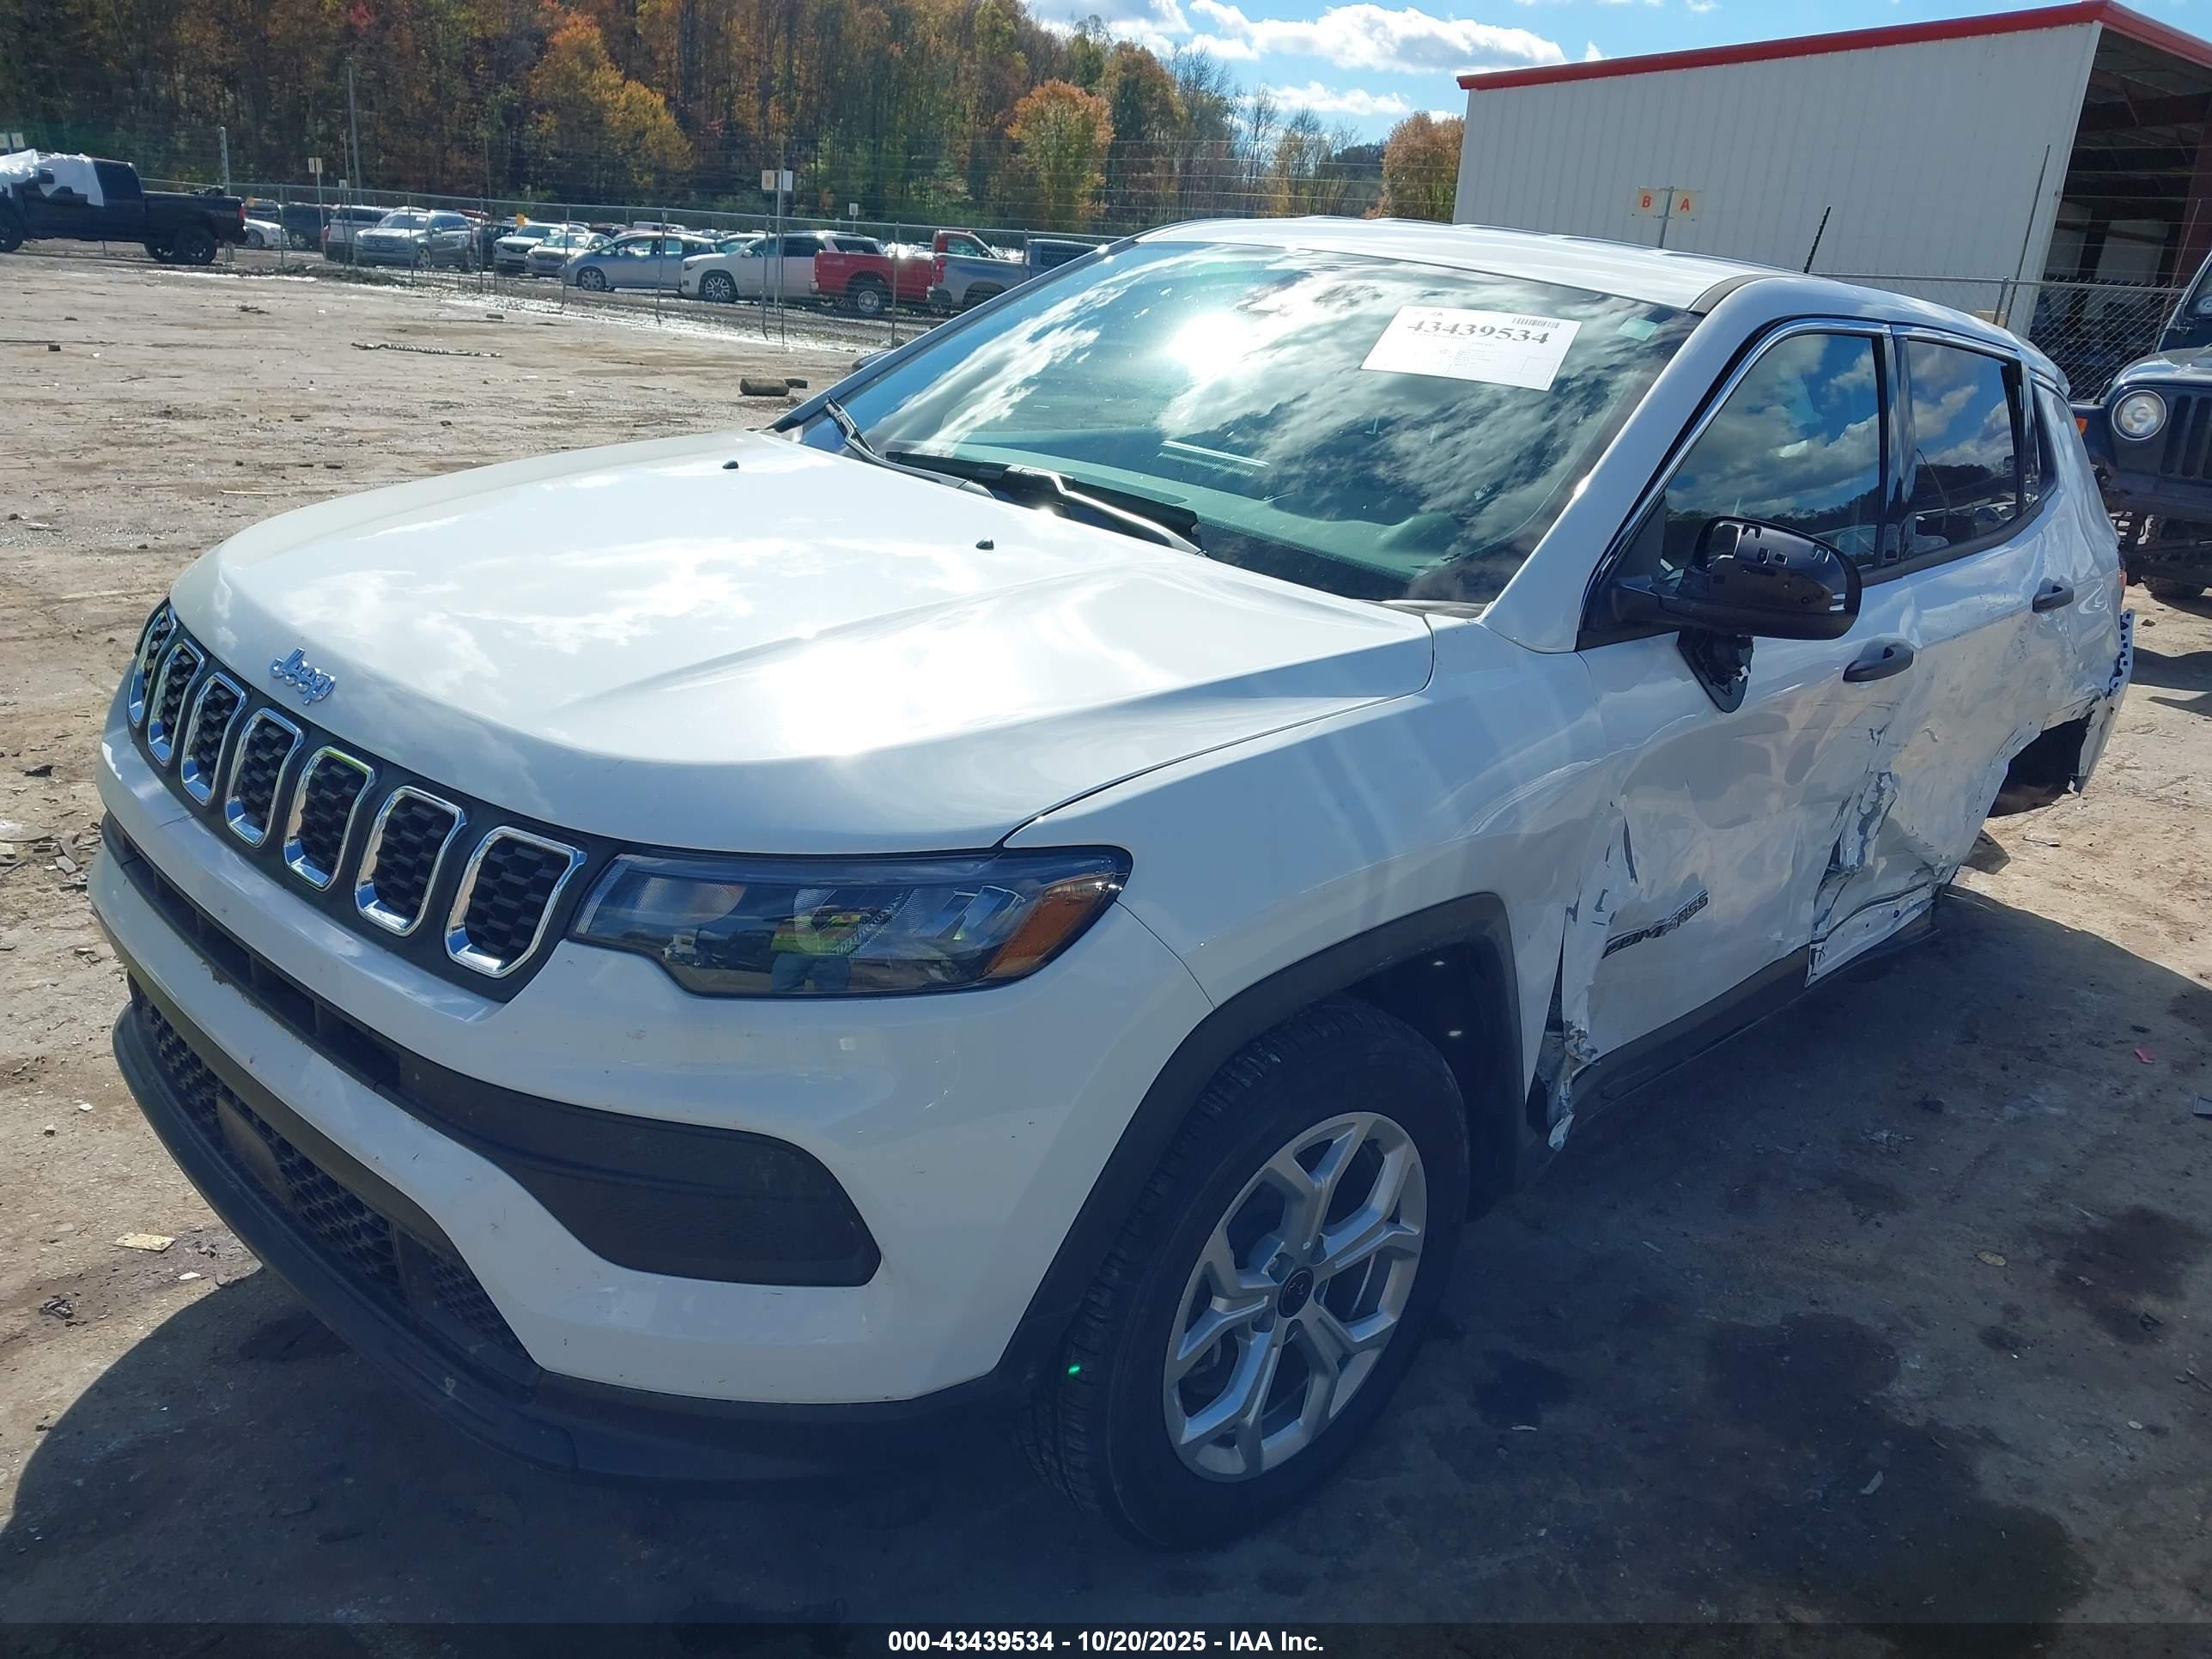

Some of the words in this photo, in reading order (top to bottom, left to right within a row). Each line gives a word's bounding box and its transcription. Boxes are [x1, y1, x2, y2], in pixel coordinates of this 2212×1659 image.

[1641, 195, 1652, 208] B
[1680, 198, 1690, 211] A
[1407, 319, 1550, 343] 43439534
[269, 647, 337, 706] Jeep
